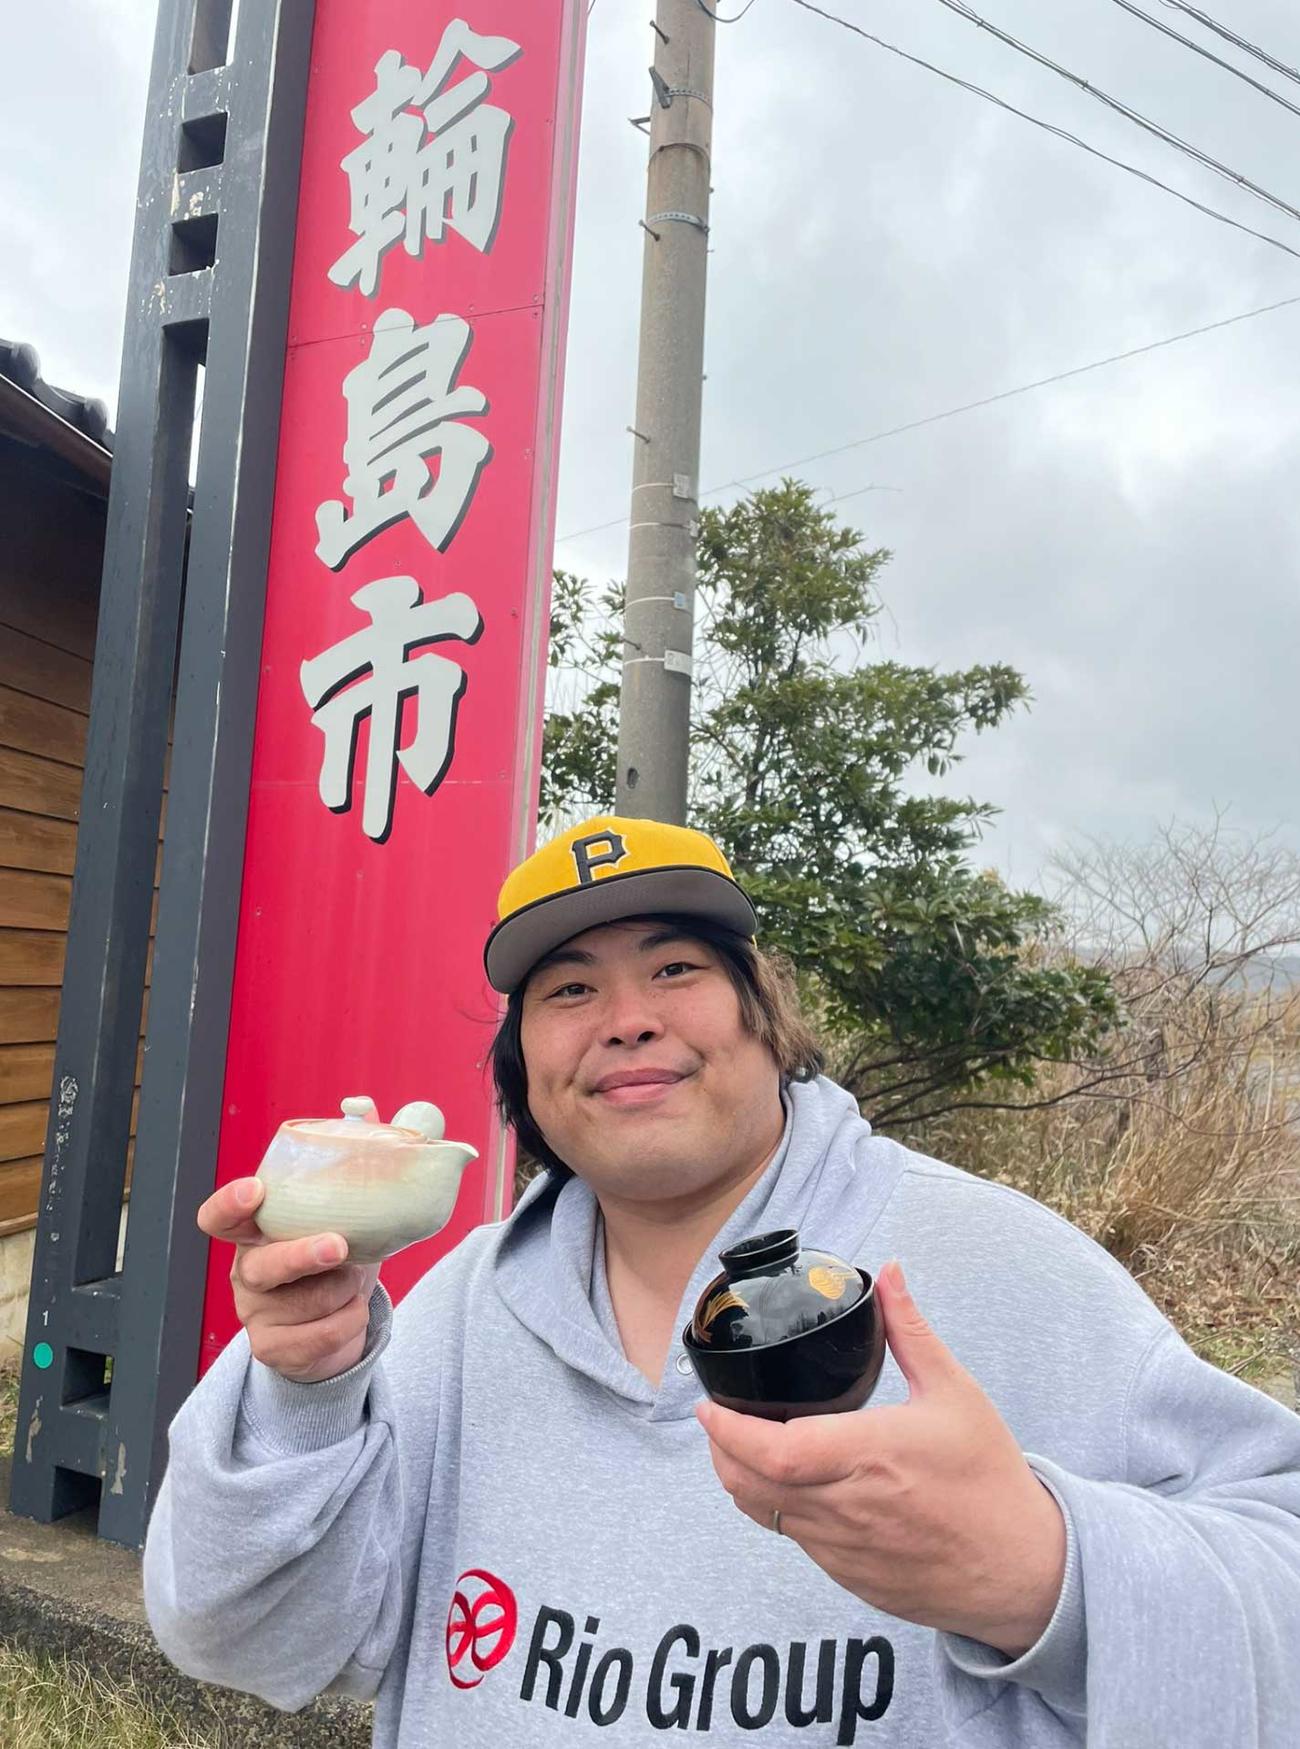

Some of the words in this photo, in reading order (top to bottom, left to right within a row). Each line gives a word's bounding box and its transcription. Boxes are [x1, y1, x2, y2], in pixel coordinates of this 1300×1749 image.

[299, 18, 521, 843] 輪島市
[571, 829, 626, 884] P
[42, 1310, 49, 1326] 1
[520, 1605, 633, 1727] Rio
[646, 1623, 895, 1746] Group
